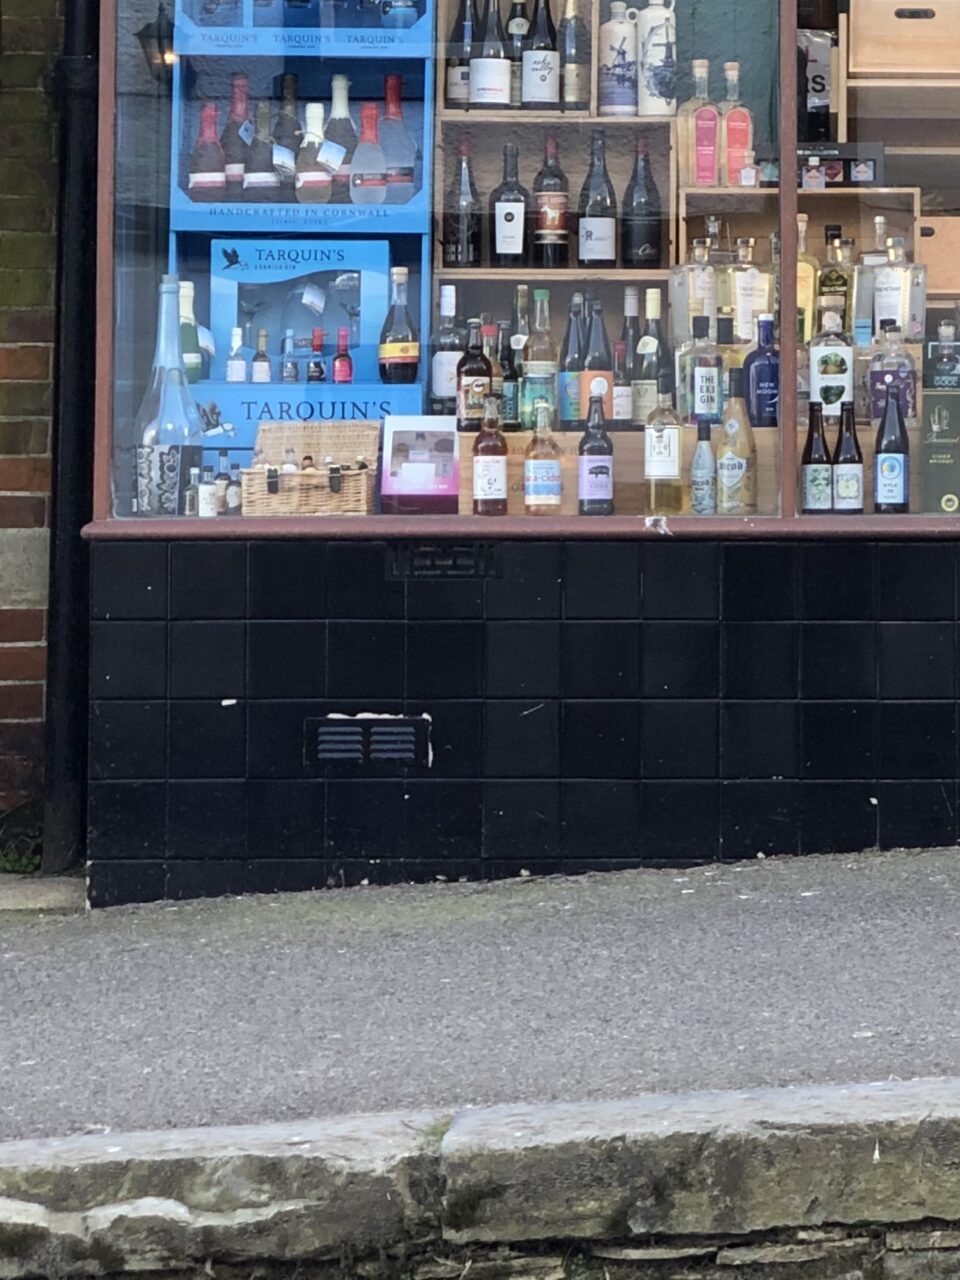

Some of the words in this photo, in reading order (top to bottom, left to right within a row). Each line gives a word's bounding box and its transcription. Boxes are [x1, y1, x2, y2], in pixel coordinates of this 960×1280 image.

[200, 33, 258, 43] TARQUIN'S
[274, 33, 331, 44] TARQUIN'S
[347, 34, 404, 44] TARQUIN'S
[209, 207, 300, 217] HANDCRAFTED
[305, 207, 318, 217] IN
[323, 208, 390, 217] CORNWALL
[255, 249, 345, 263] TARQUIN'S
[700, 375, 715, 384] THE
[699, 394, 715, 404] GIN
[241, 400, 392, 420] TARQUIN'S
